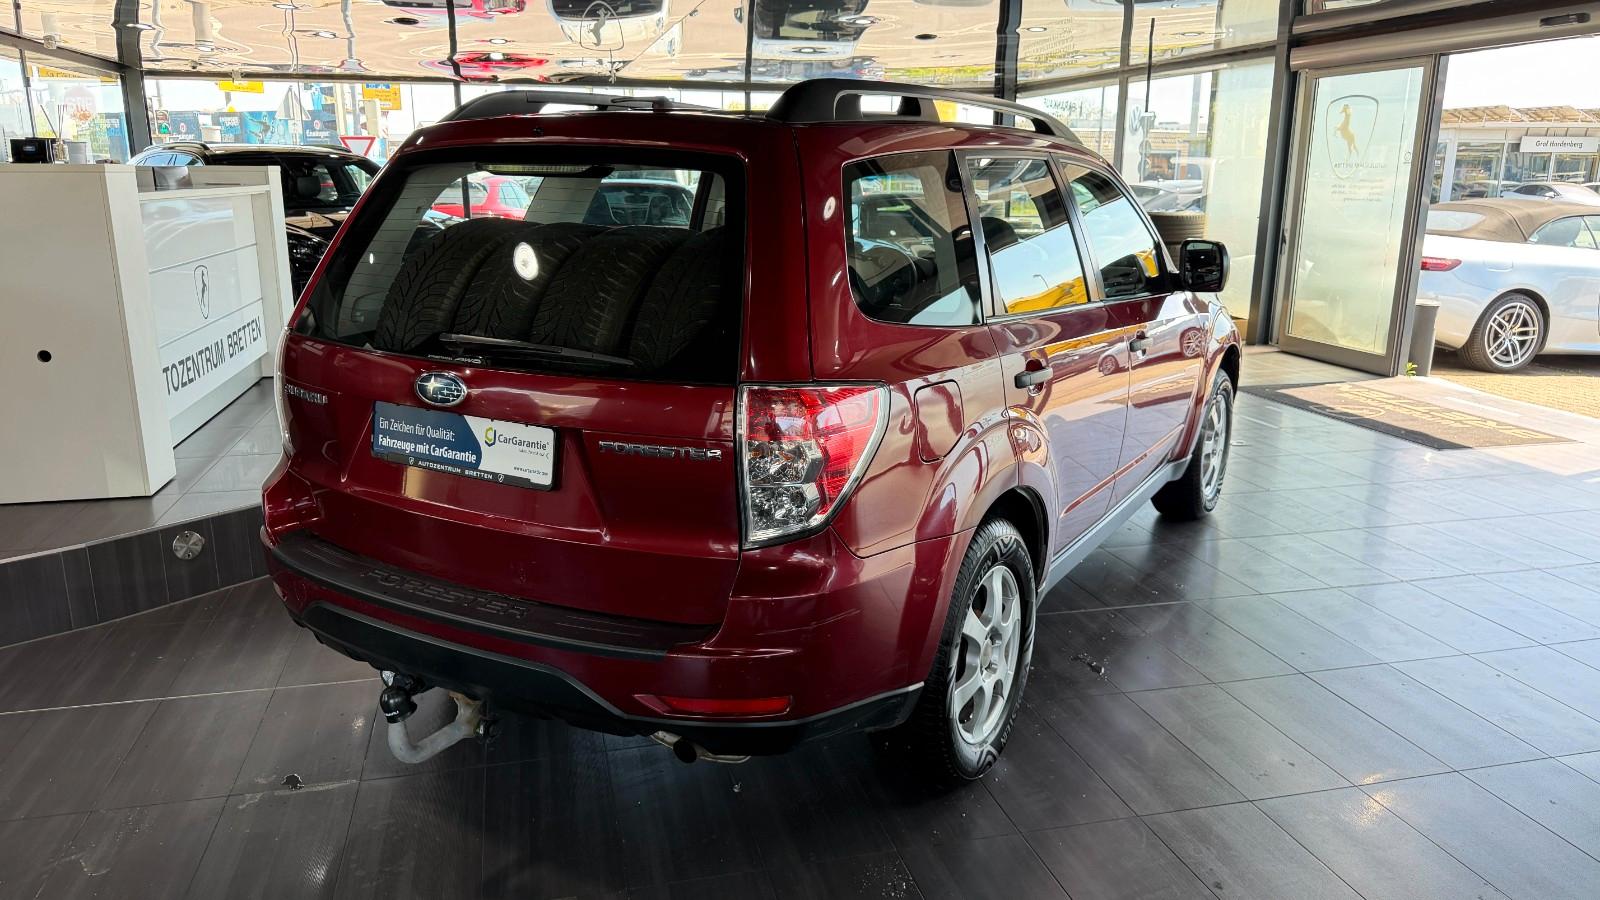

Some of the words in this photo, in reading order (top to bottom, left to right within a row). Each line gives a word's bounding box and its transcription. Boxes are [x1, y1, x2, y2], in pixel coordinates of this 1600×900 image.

[162, 338, 226, 396] TOZENTRUM
[227, 316, 262, 359] BRETTEN
[379, 417, 389, 430] Ein
[390, 419, 415, 435] Zeichen
[415, 424, 426, 436] für
[378, 434, 416, 454] Fahrzeuge
[415, 443, 430, 455] mit
[430, 444, 477, 464] CarGarantie
[599, 440, 722, 461] FORESTER
[418, 460, 461, 473] AUTOZENTRUM
[464, 469, 493, 479] BRETTEN
